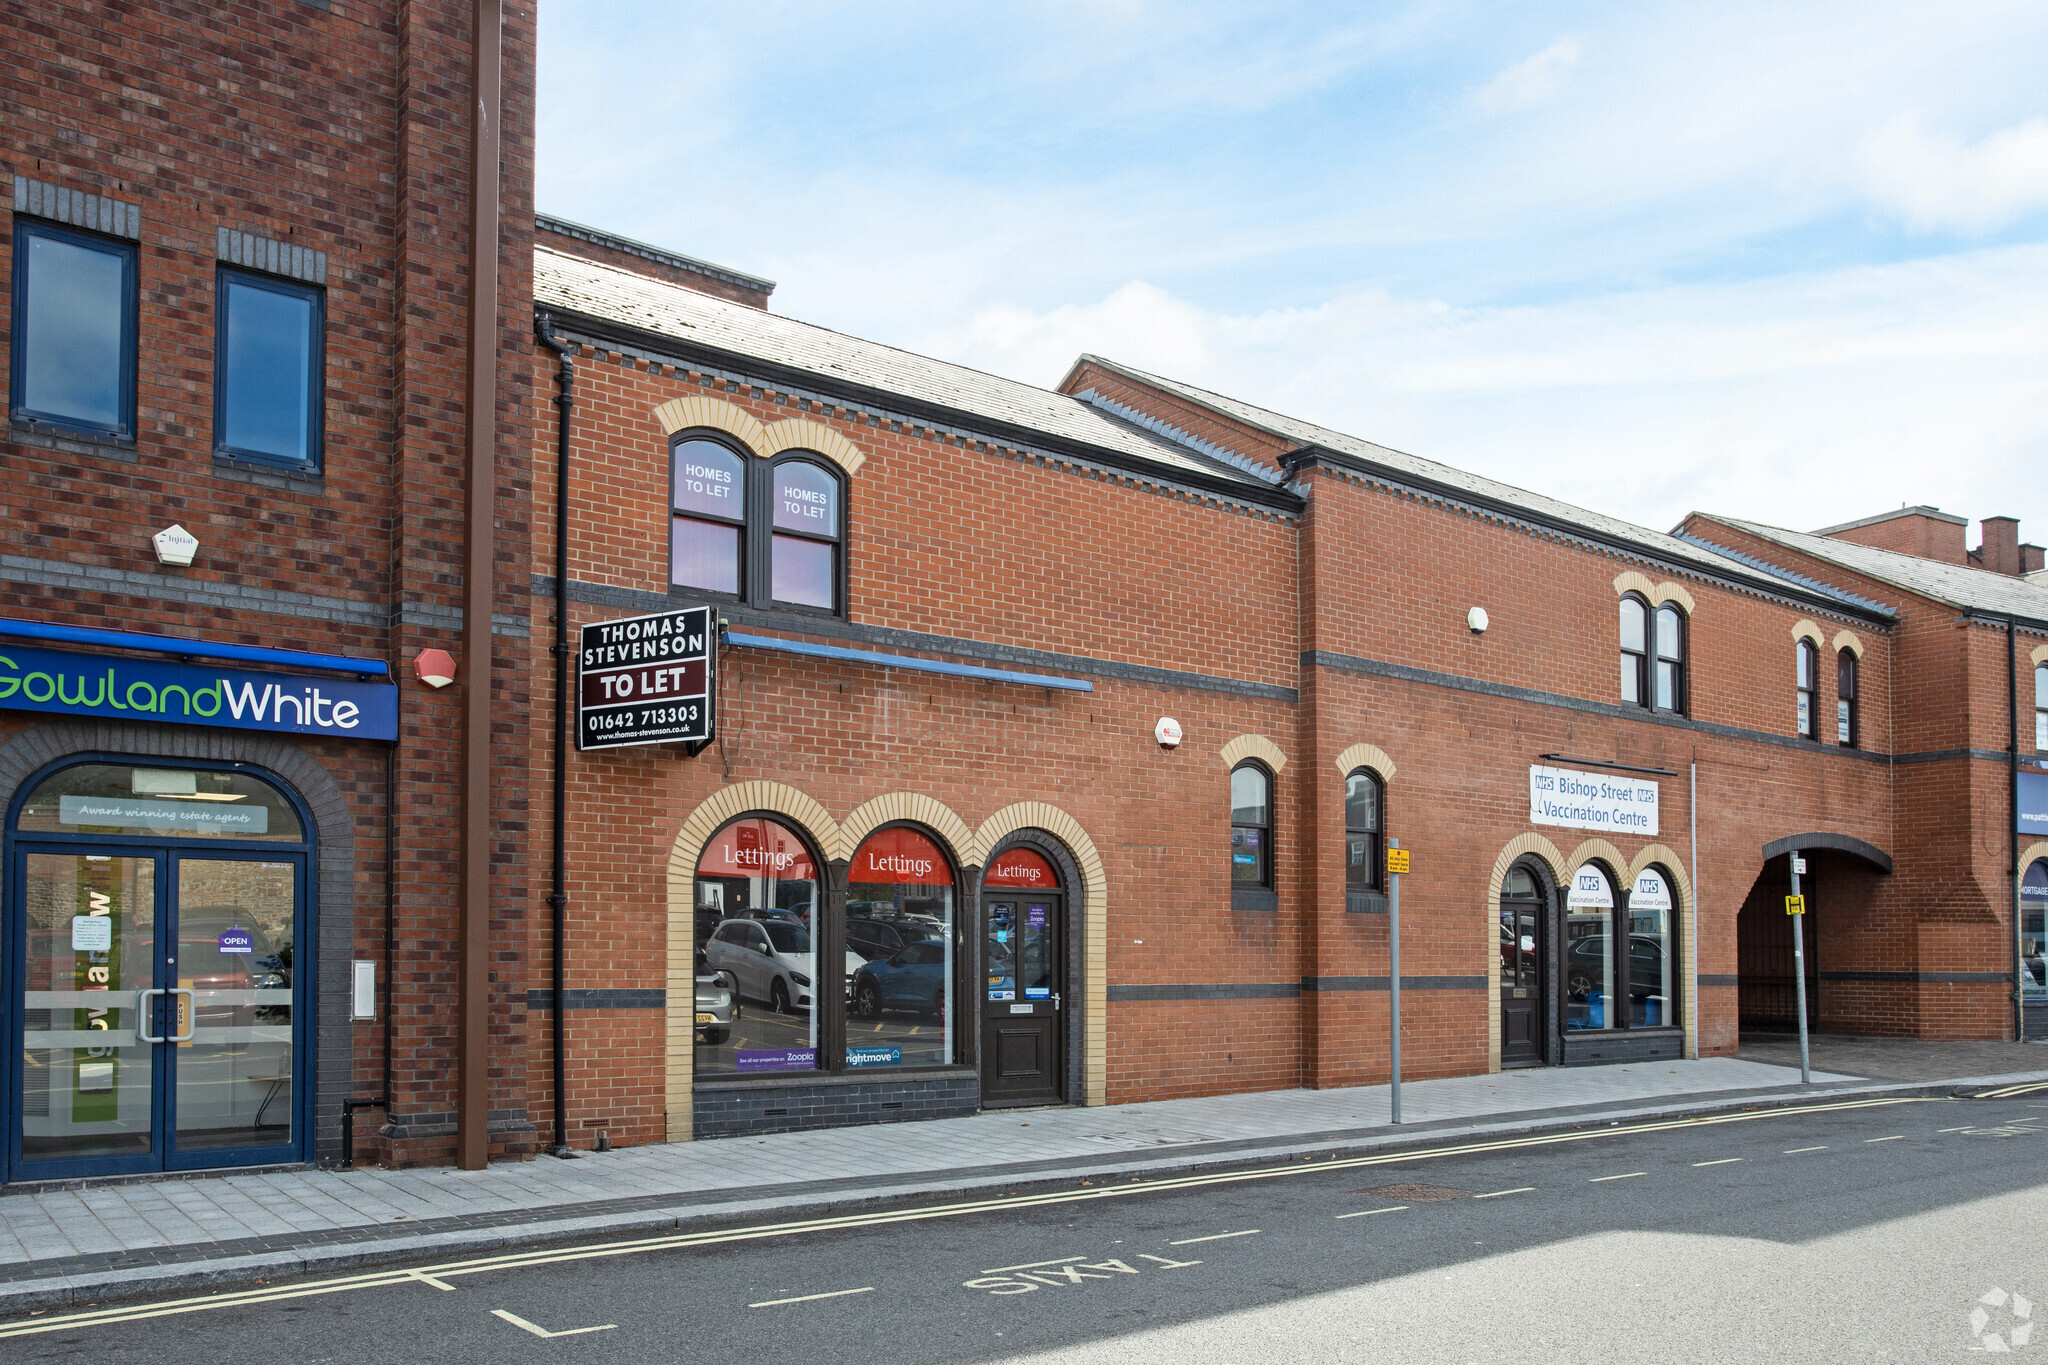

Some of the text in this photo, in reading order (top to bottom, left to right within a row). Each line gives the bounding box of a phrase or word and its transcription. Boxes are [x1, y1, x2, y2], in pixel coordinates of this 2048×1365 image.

[685, 463, 732, 483] HOMES
[685, 479, 730, 498] TO LET
[784, 486, 827, 505] HOMES
[783, 501, 826, 519] TO LET
[601, 615, 685, 644] THOMAS
[584, 633, 703, 666] STEVENSON
[600, 667, 686, 699] TO LET
[588, 705, 698, 731] 01642 713303
[596, 723, 690, 740] www.thomas-stevenson.co.uk
[1535, 775, 1654, 803] NHS Bishop Street NHS
[79, 804, 251, 823] Award winning estate agents
[1543, 800, 1648, 827] Vaccination Centre
[724, 844, 794, 871] Lettings
[869, 853, 932, 877] Lettings
[997, 863, 1041, 881] Lettings
[1580, 876, 1599, 890] NHS
[1640, 879, 1658, 893] NHS
[224, 937, 248, 945] OPEN
[787, 1052, 814, 1061] Zoopla
[846, 1053, 892, 1065] rightmove
[962, 1254, 1205, 1295] TAXIS
